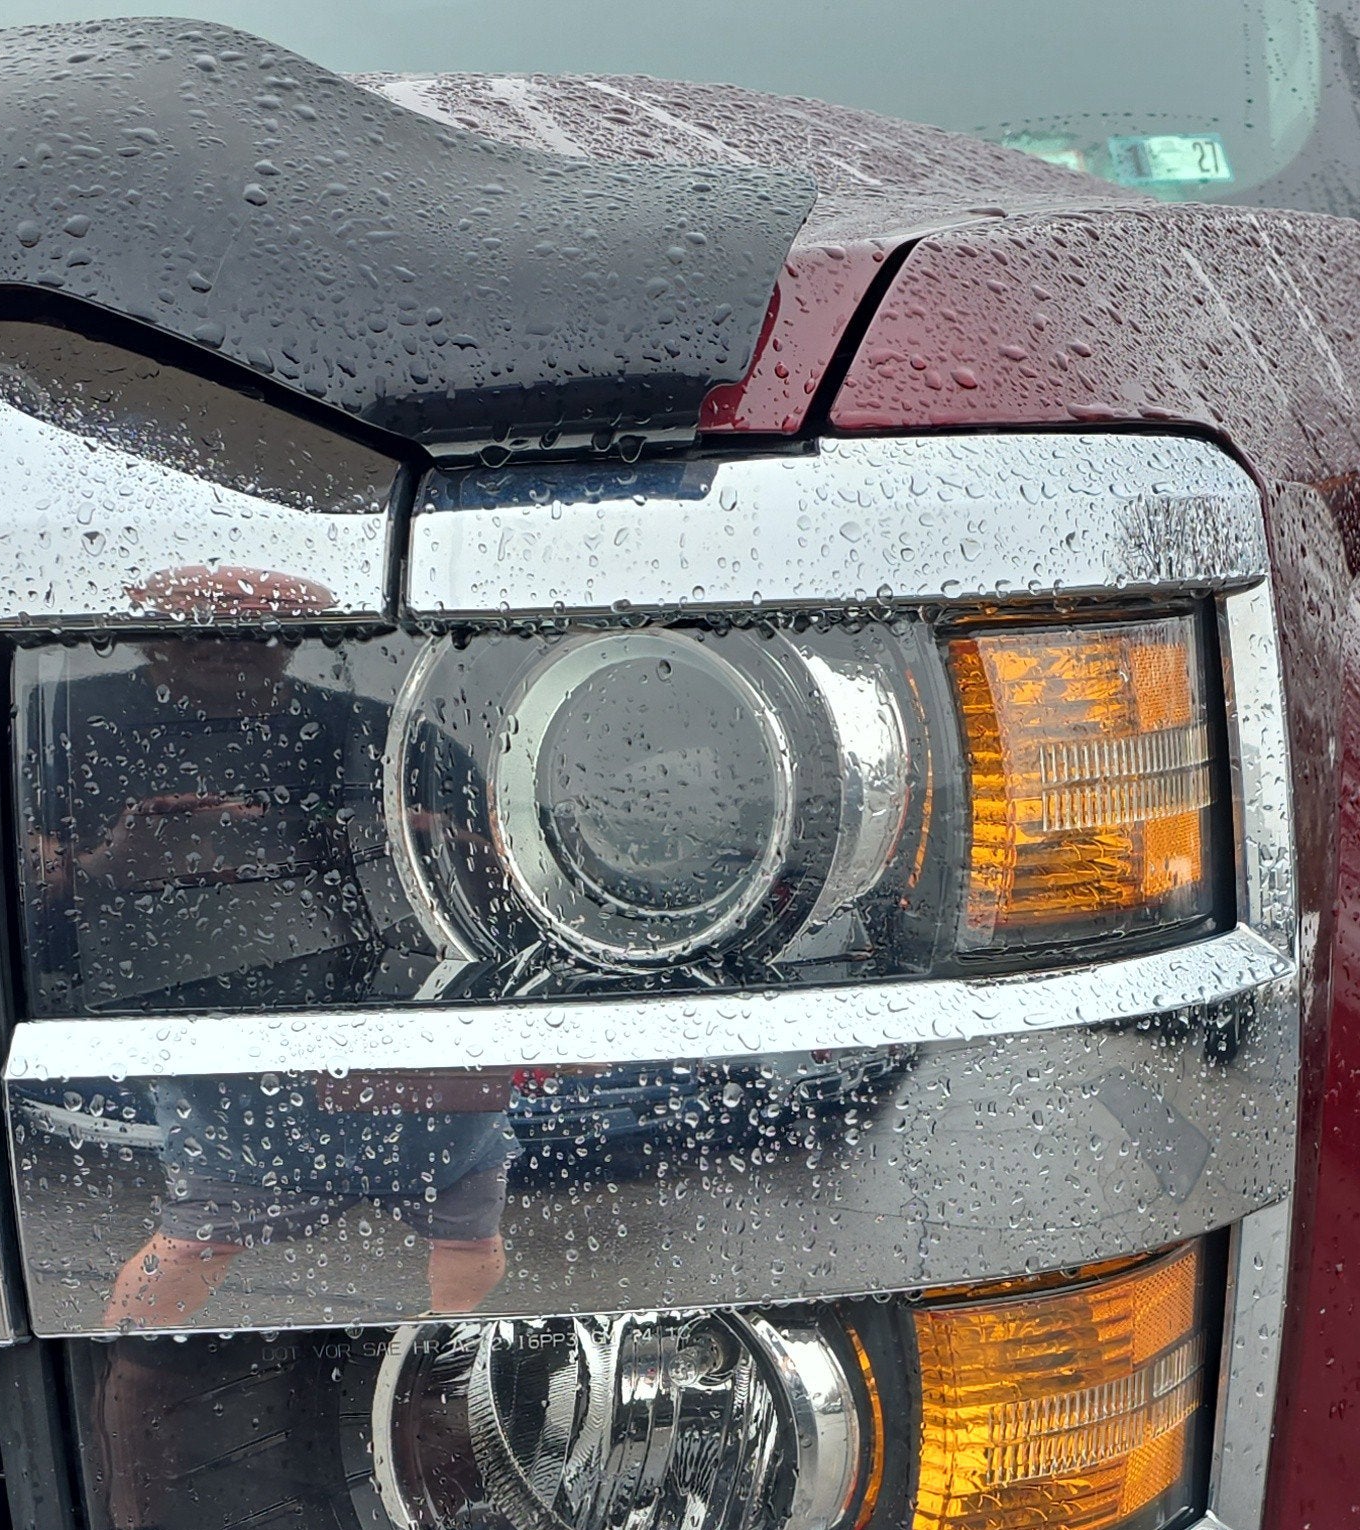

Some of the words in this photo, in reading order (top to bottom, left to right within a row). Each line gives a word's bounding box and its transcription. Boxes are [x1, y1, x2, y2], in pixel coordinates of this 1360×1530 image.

[1192, 140, 1220, 174] 27
[312, 1341, 352, 1360] VOR
[363, 1340, 403, 1357] SAE
[413, 1339, 441, 1355] HR
